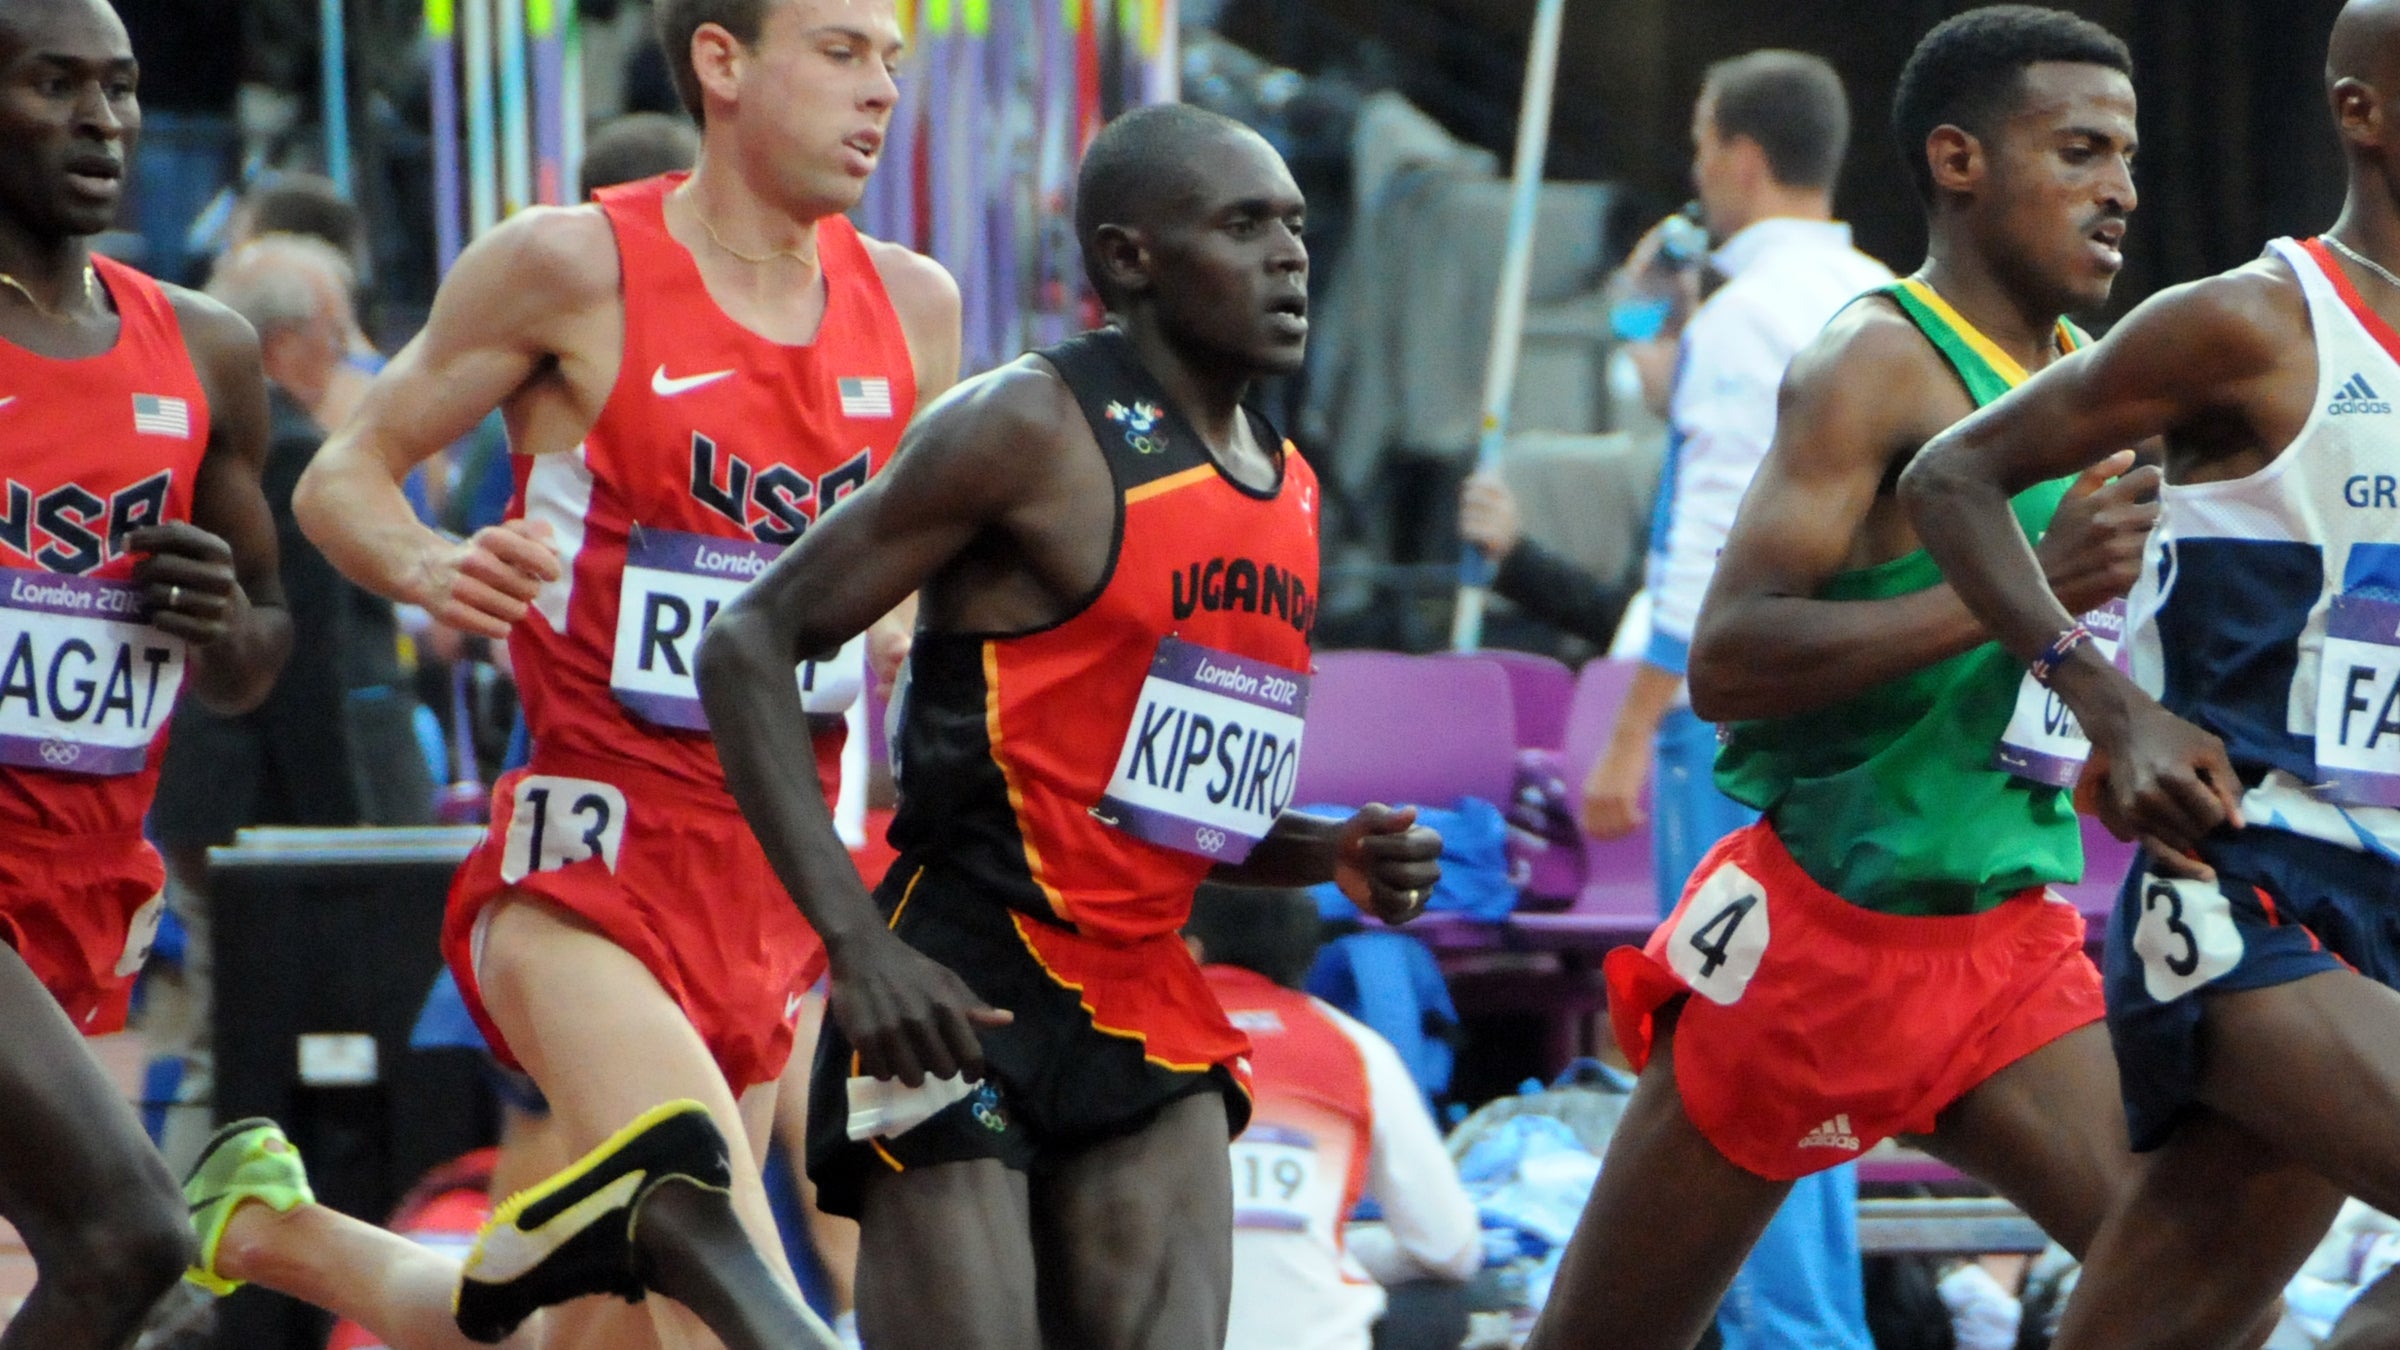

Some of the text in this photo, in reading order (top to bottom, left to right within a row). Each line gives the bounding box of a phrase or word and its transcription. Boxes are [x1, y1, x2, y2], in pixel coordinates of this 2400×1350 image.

[2328, 399, 2391, 415] adidas
[11, 577, 91, 609] London
[1194, 657, 1298, 706] London 2012
[1127, 701, 1296, 820] KIPSIRO
[525, 787, 611, 873] 13
[1690, 894, 1758, 978] 4
[2146, 880, 2199, 977] 3
[1244, 1155, 1304, 1201] 19
